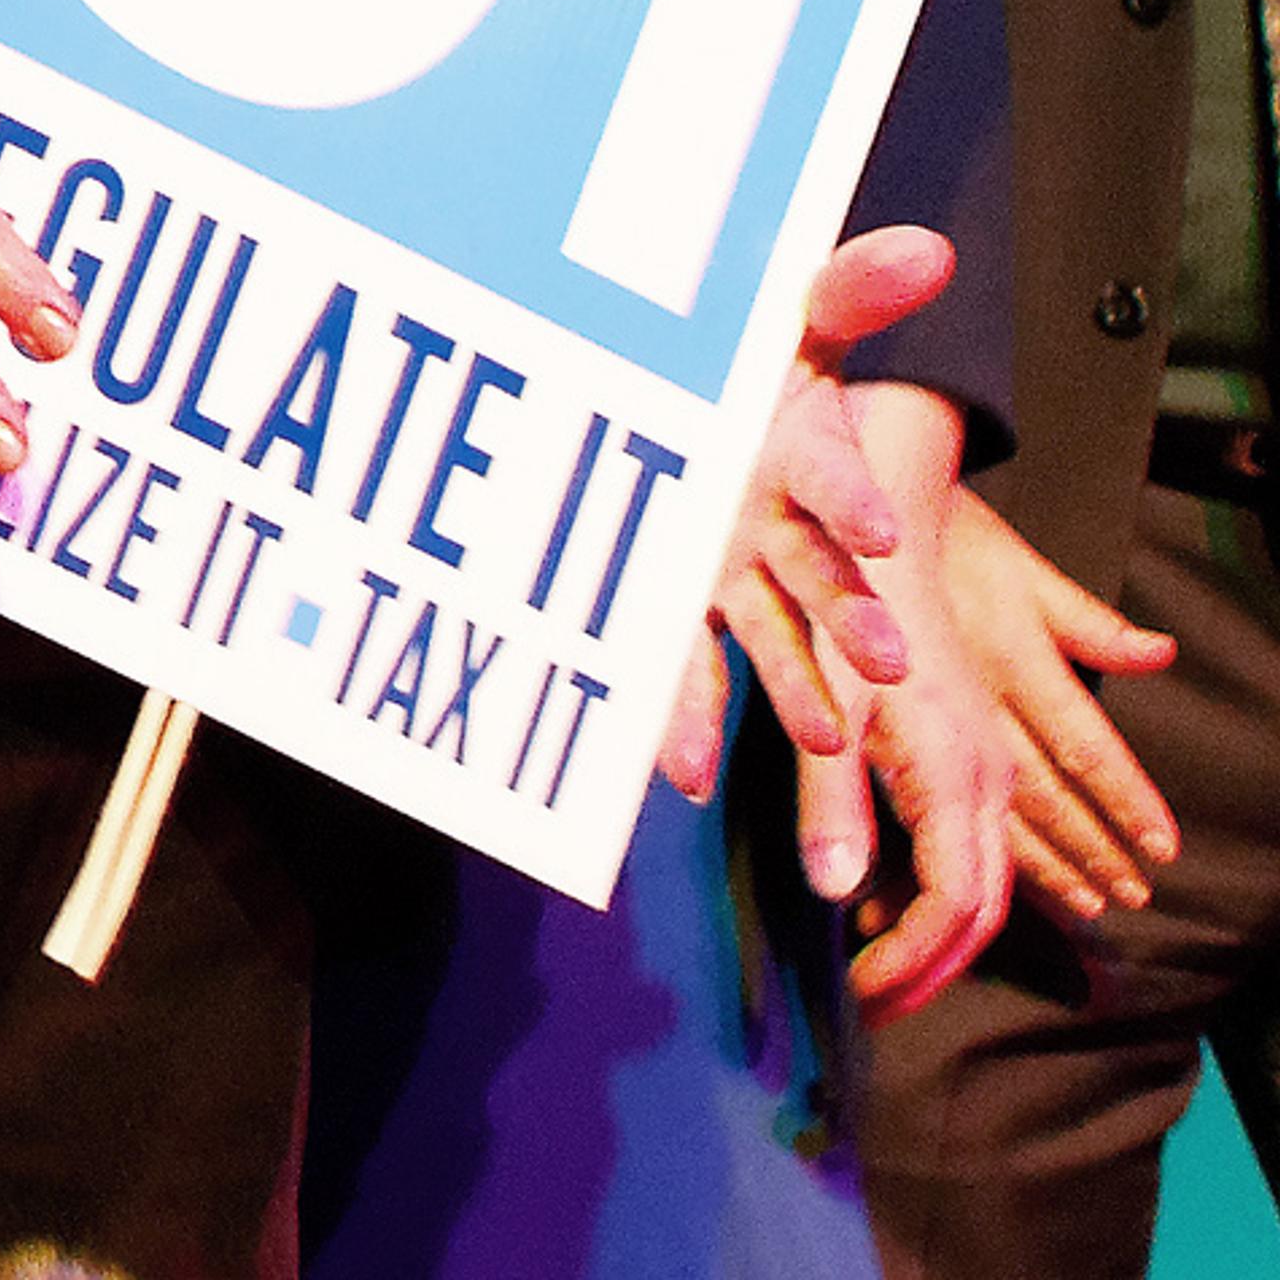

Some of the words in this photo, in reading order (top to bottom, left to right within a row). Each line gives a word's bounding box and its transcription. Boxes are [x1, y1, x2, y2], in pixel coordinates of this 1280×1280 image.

[180, 501, 283, 647] IT
[336, 570, 503, 765] TAX
[506, 662, 611, 809] IT
[527, 416, 687, 640] IT
